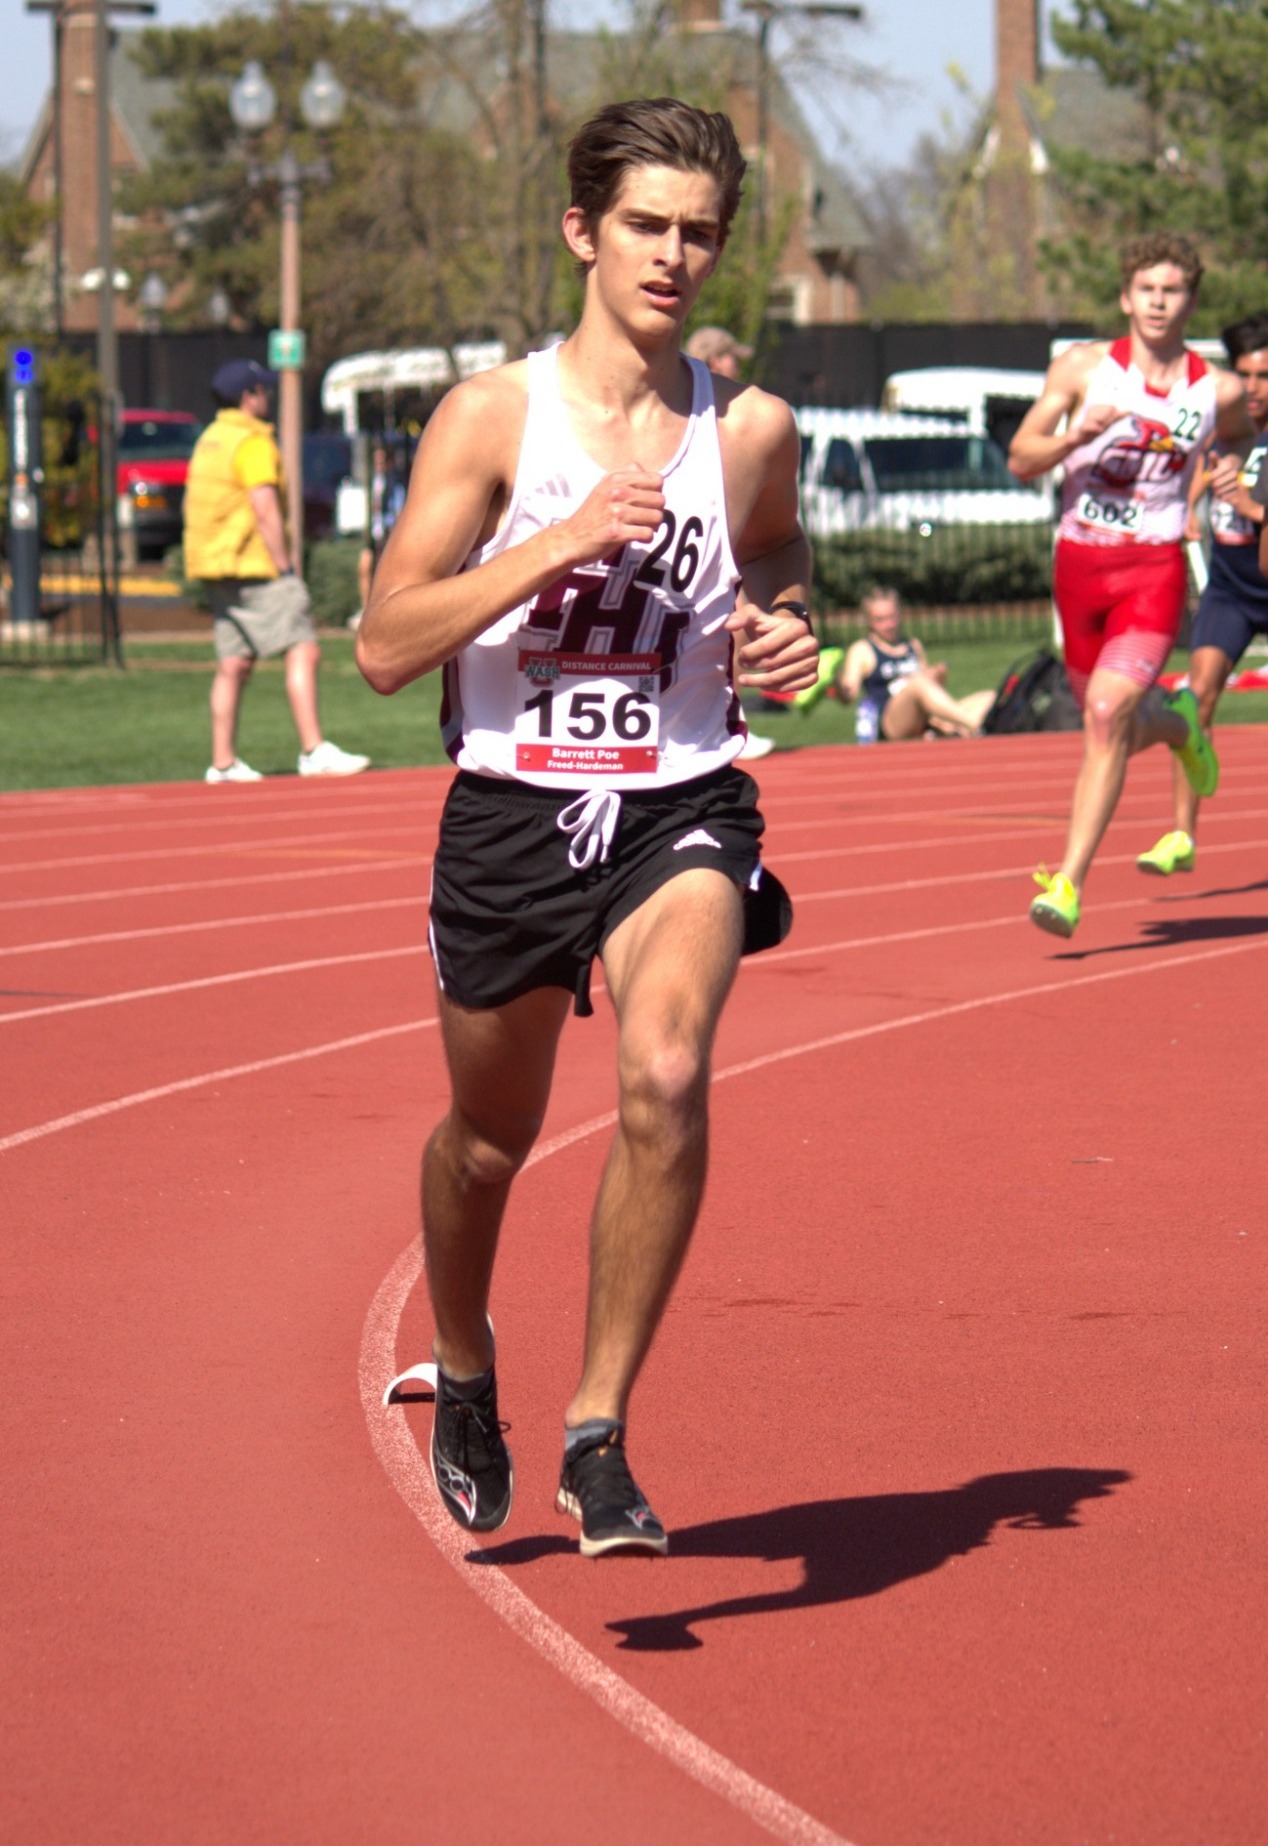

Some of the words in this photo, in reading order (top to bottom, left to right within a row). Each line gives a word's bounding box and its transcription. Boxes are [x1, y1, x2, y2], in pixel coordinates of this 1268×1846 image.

[1172, 408, 1202, 442] 22
[1083, 499, 1138, 528] 602
[633, 508, 704, 593] 26
[525, 664, 561, 679] WASH
[561, 660, 606, 671] DISTANCE
[608, 661, 652, 671] CARNIVAL
[524, 689, 652, 741] 156
[552, 747, 595, 760] Barrett
[597, 748, 620, 760] Poe
[547, 760, 624, 771] Freed-Hardeman
